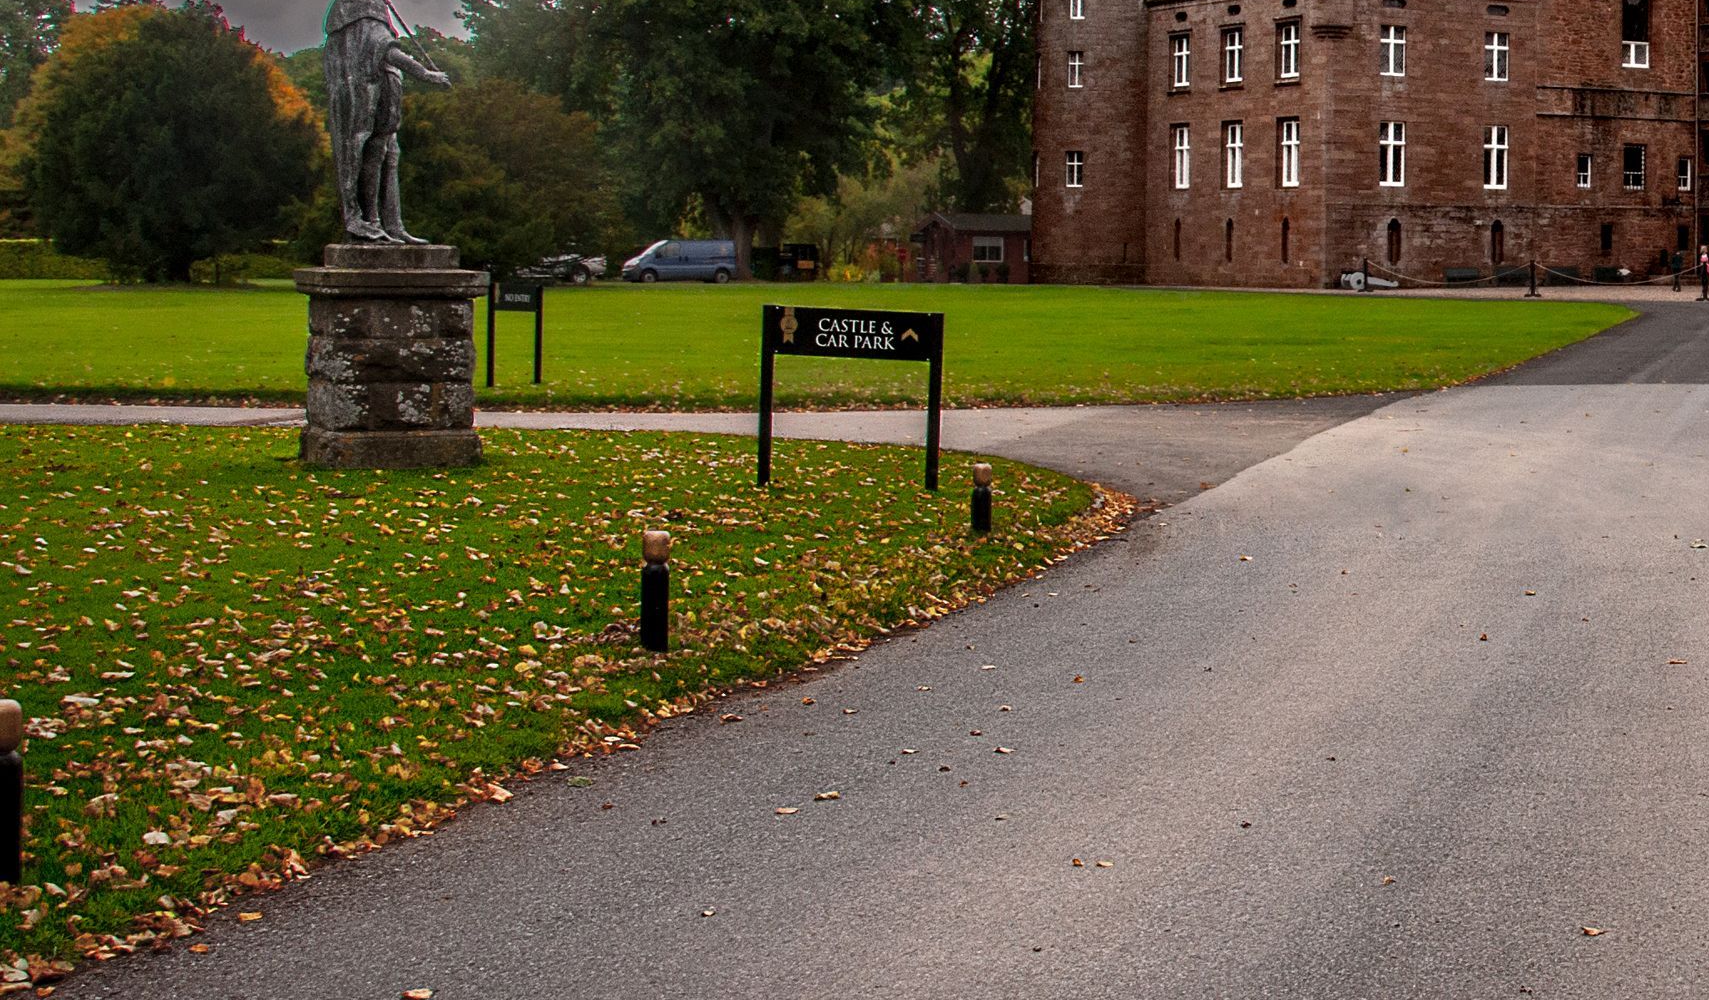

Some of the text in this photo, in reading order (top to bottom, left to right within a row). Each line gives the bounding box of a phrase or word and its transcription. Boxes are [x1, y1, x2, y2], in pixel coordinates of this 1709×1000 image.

[818, 318, 894, 335] CASTLE &
[815, 333, 896, 350] CAR PARK
